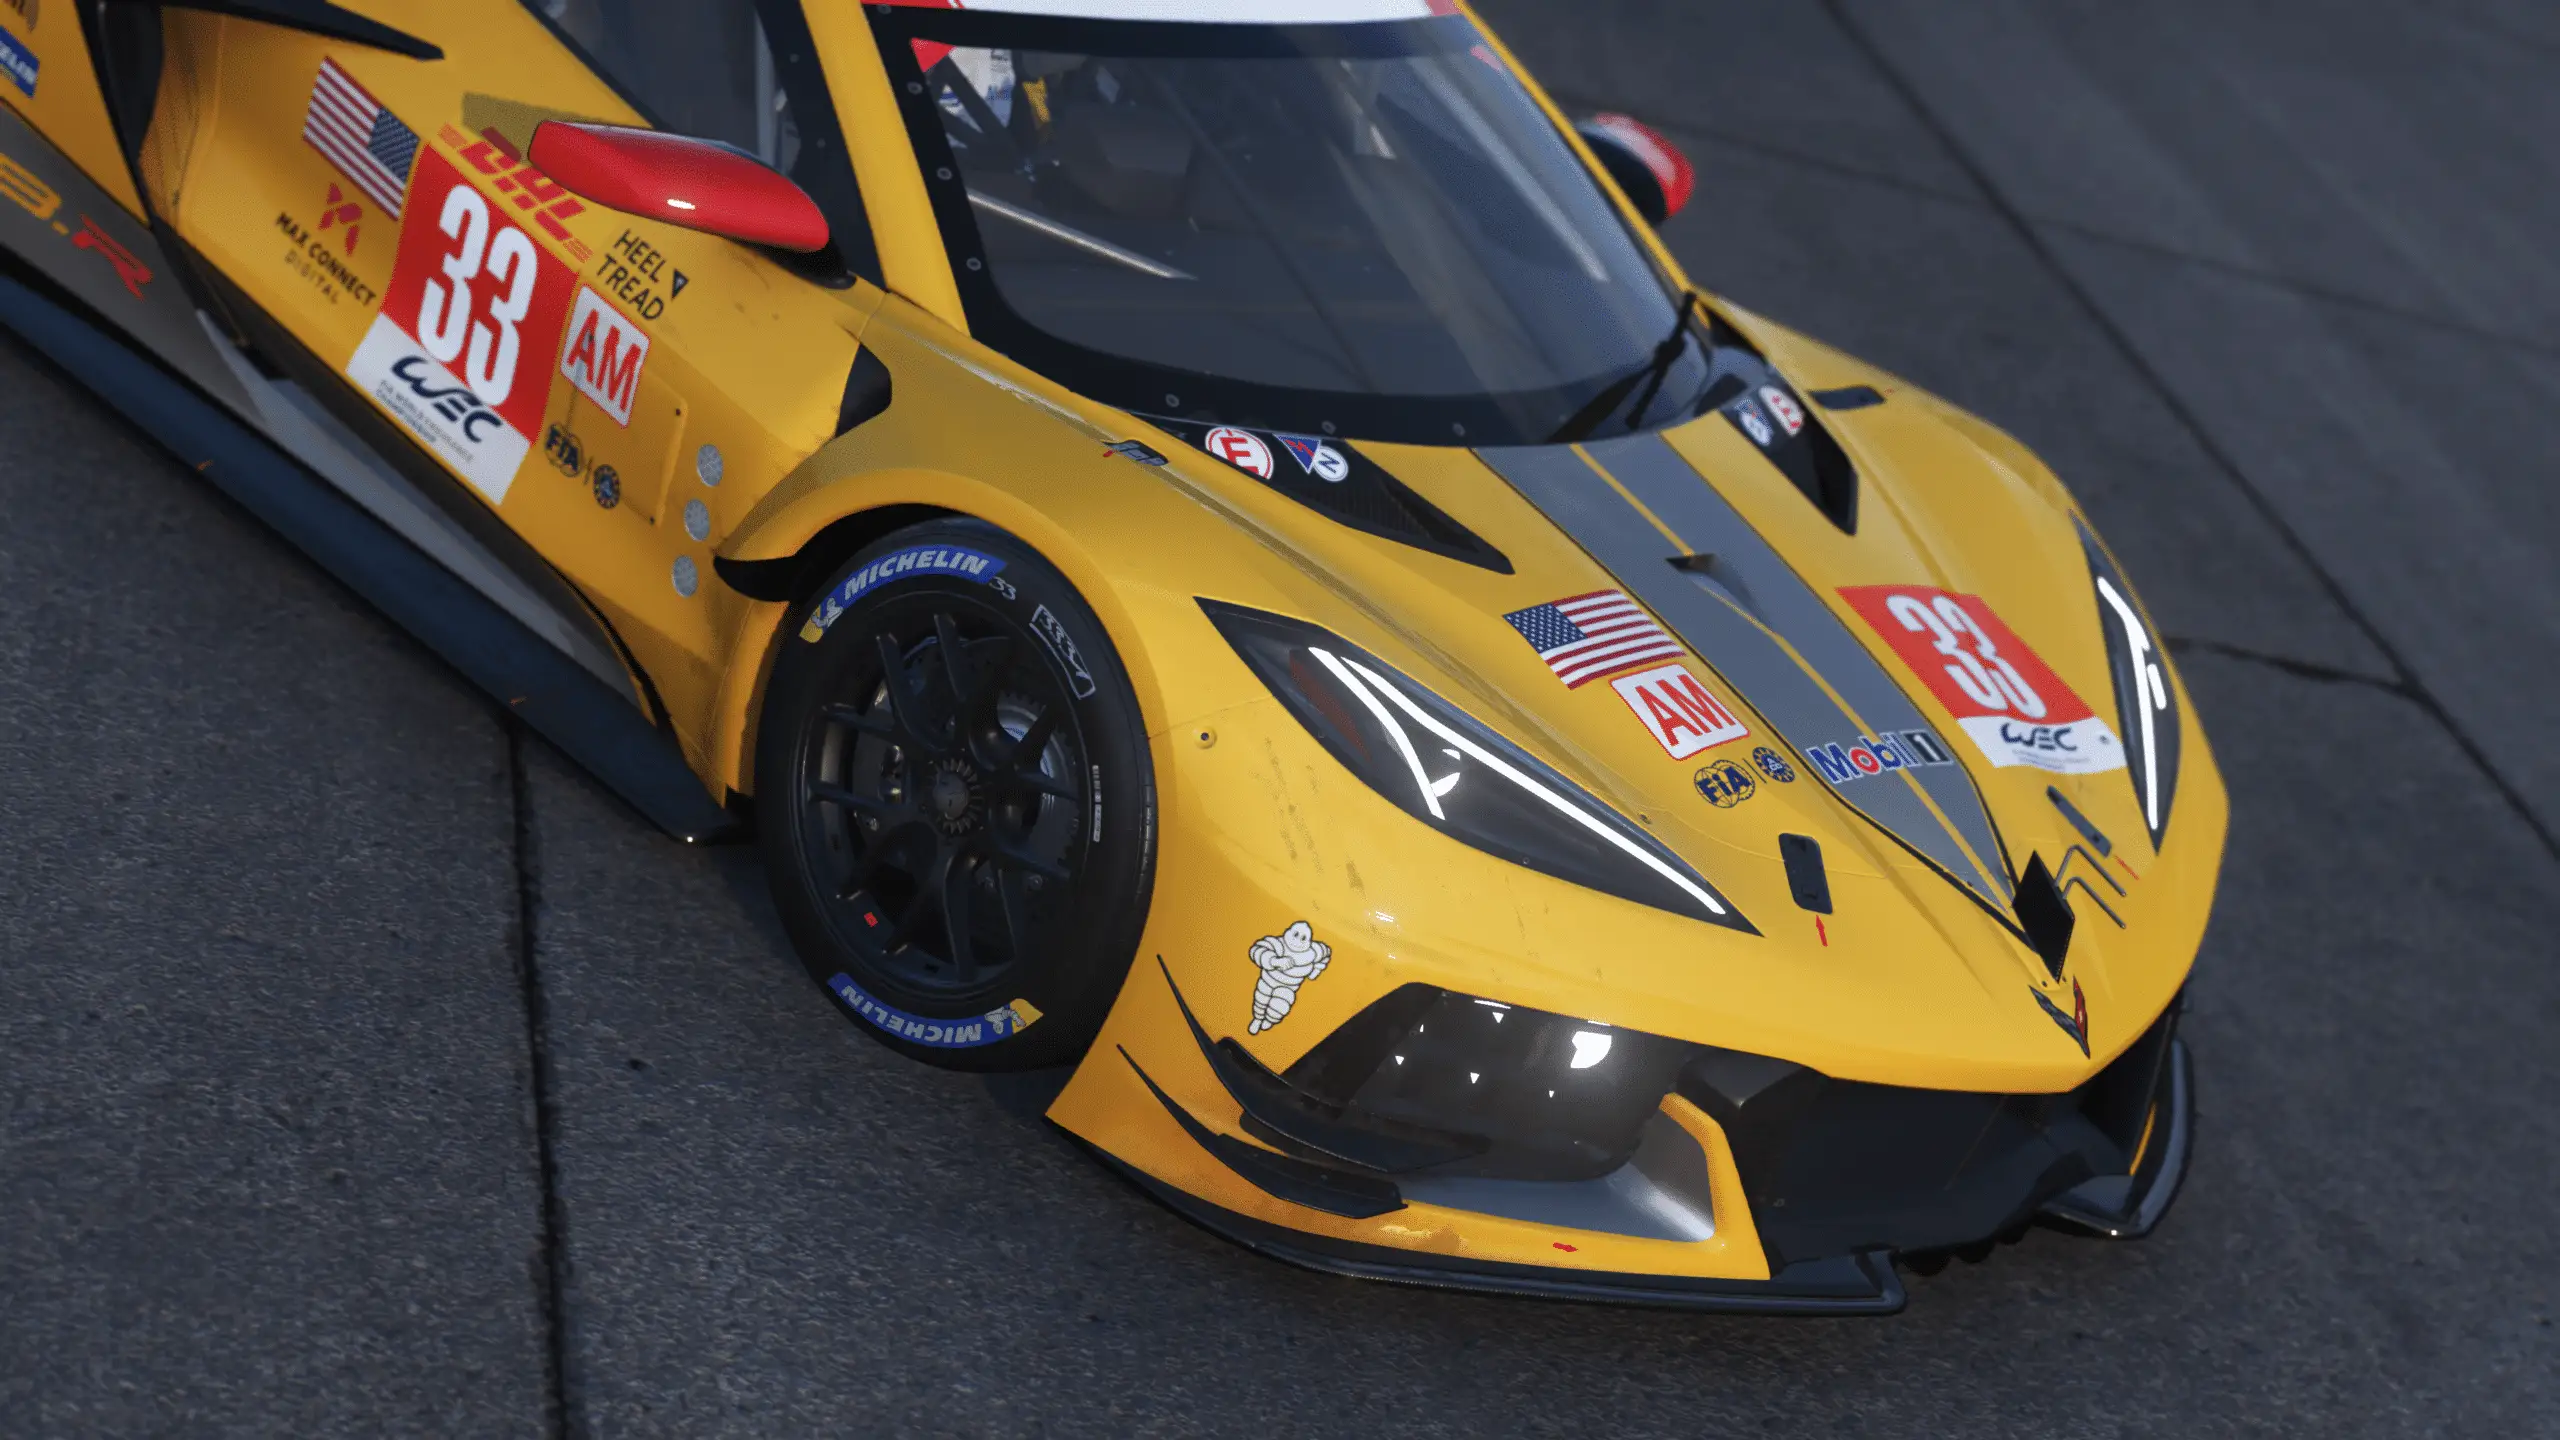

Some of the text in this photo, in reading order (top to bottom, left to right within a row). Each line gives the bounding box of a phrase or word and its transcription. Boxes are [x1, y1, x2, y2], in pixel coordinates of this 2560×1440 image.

[275, 211, 377, 307] MAX CONNECT
[597, 253, 663, 321] TREAD
[614, 229, 667, 283] HEEL
[417, 184, 538, 407] 33
[568, 308, 642, 412] AM
[391, 355, 503, 443] WEC
[845, 550, 989, 600] MICHELIN
[1886, 595, 2047, 718] 33
[1636, 673, 1736, 747] AM
[2000, 722, 2078, 752] WEC
[1806, 732, 1921, 783] Mobil
[841, 985, 982, 1043] MICHELIN
